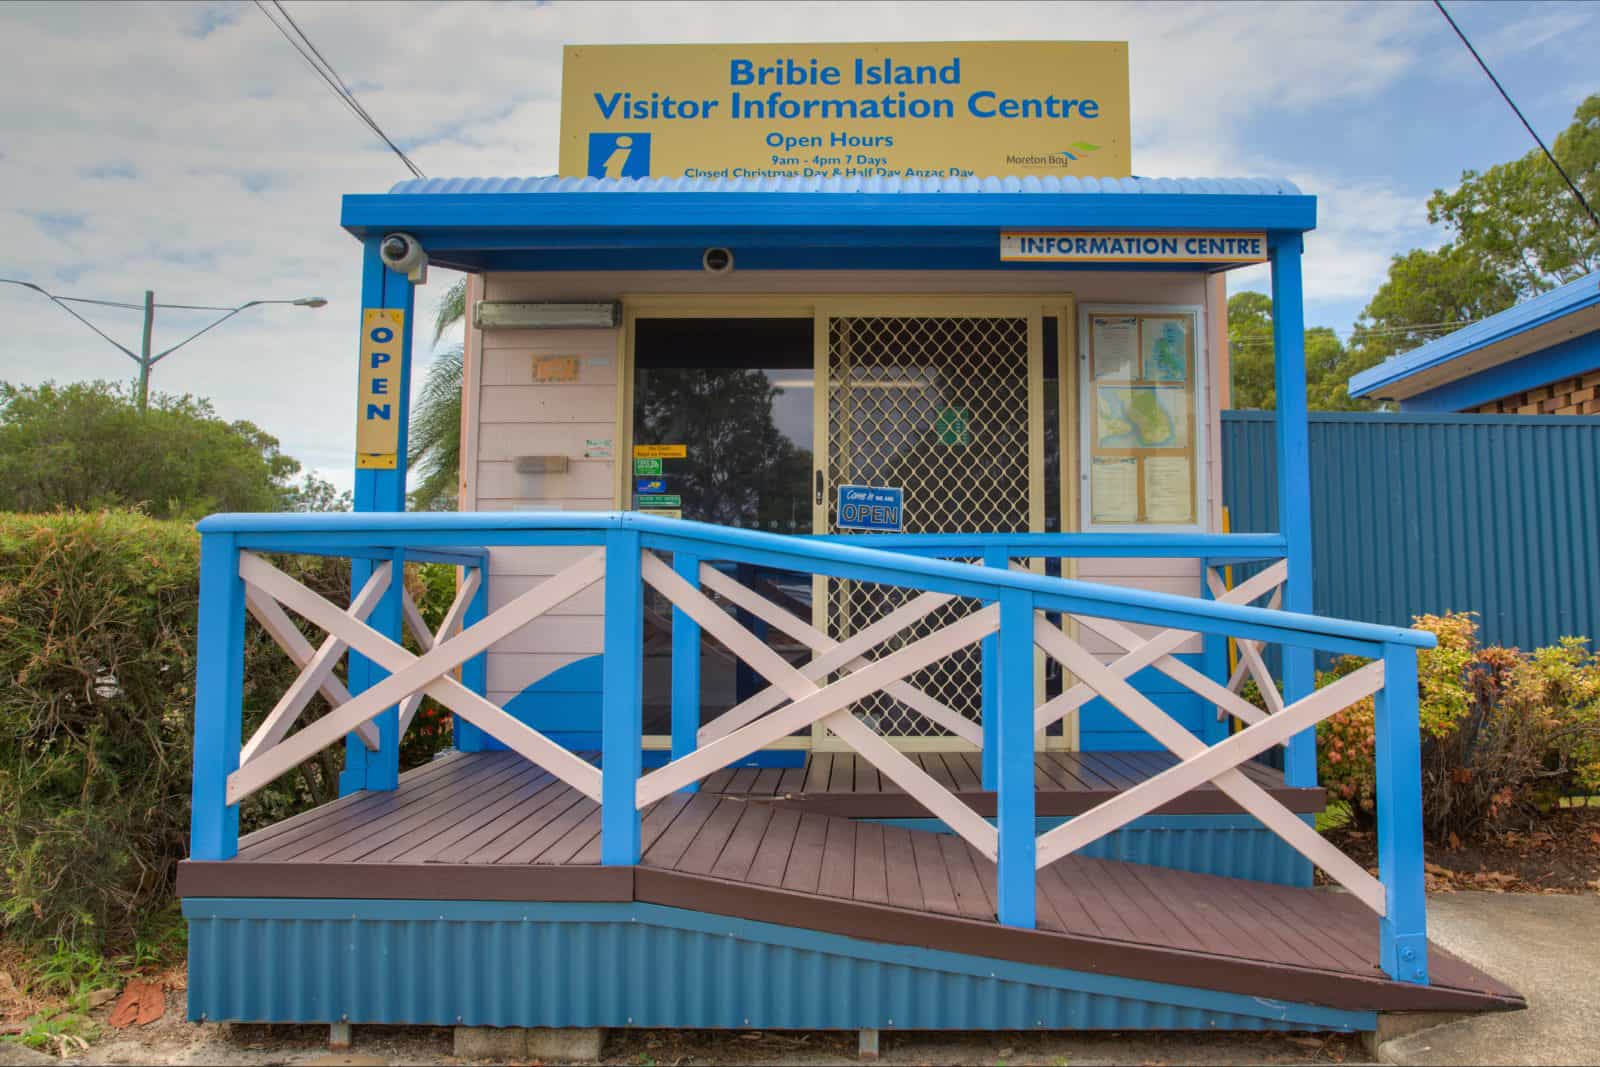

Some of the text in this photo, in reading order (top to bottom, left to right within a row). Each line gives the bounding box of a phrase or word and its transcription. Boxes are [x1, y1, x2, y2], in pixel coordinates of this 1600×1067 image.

[730, 57, 961, 86] Bribie Island
[593, 90, 1100, 120] Visitor Information Centre
[766, 131, 894, 151] Open Hours
[771, 155, 799, 166] 9am
[812, 154, 841, 168] 4pm
[845, 154, 852, 165] 7
[856, 154, 887, 168] Days
[1006, 155, 1069, 168] Moreton Bay
[684, 167, 729, 178] Closed
[733, 167, 799, 178] Christmas
[803, 167, 828, 178] Day
[832, 167, 842, 178] &
[877, 167, 901, 178] Day
[905, 167, 945, 178] Anzac
[949, 167, 975, 178] Day
[1020, 236, 1261, 255] INFORMATION CENTRE
[367, 327, 393, 420] OPEN
[843, 504, 897, 524] OPEN
